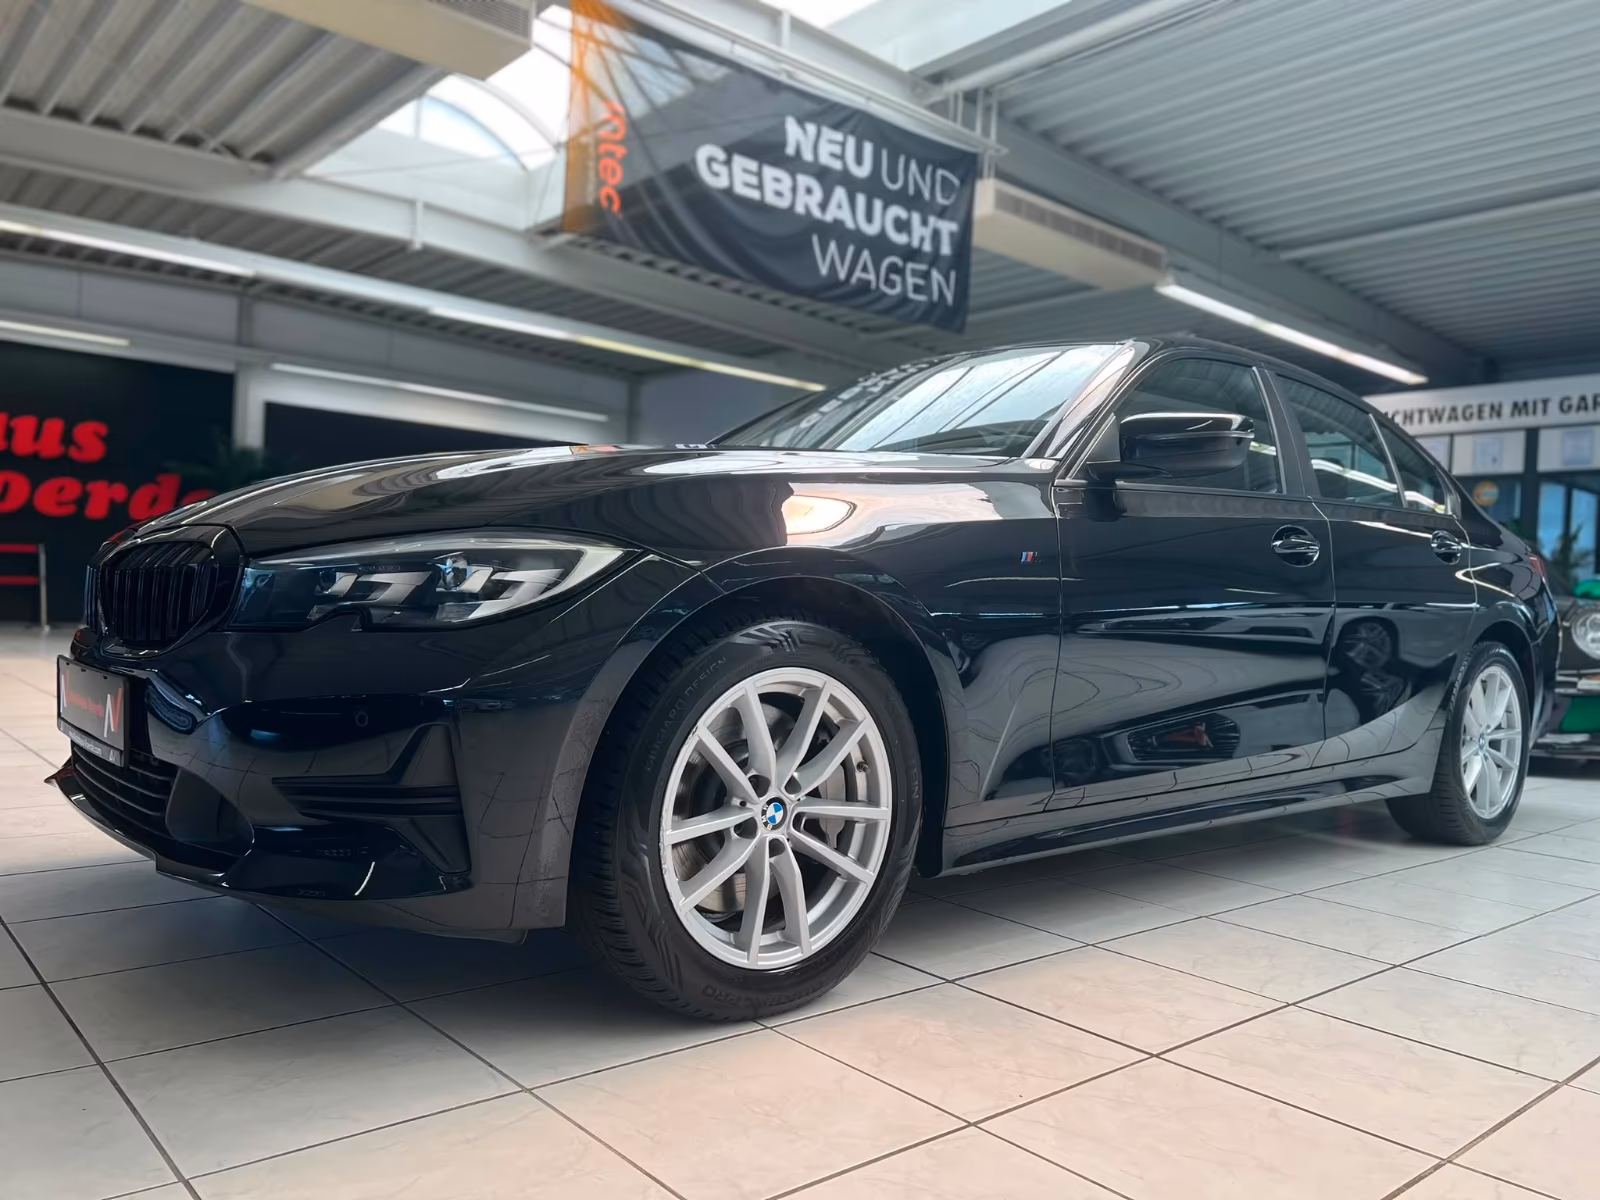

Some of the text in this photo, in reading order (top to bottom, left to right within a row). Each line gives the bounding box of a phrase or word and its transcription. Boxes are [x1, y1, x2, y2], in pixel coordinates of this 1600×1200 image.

[696, 143, 959, 256] GEBRAUCHT
[785, 115, 961, 206] NEU UND
[812, 233, 956, 306] WAGEN
[1384, 401, 1504, 427] CHTWAGEN
[1510, 398, 1553, 418] MIT
